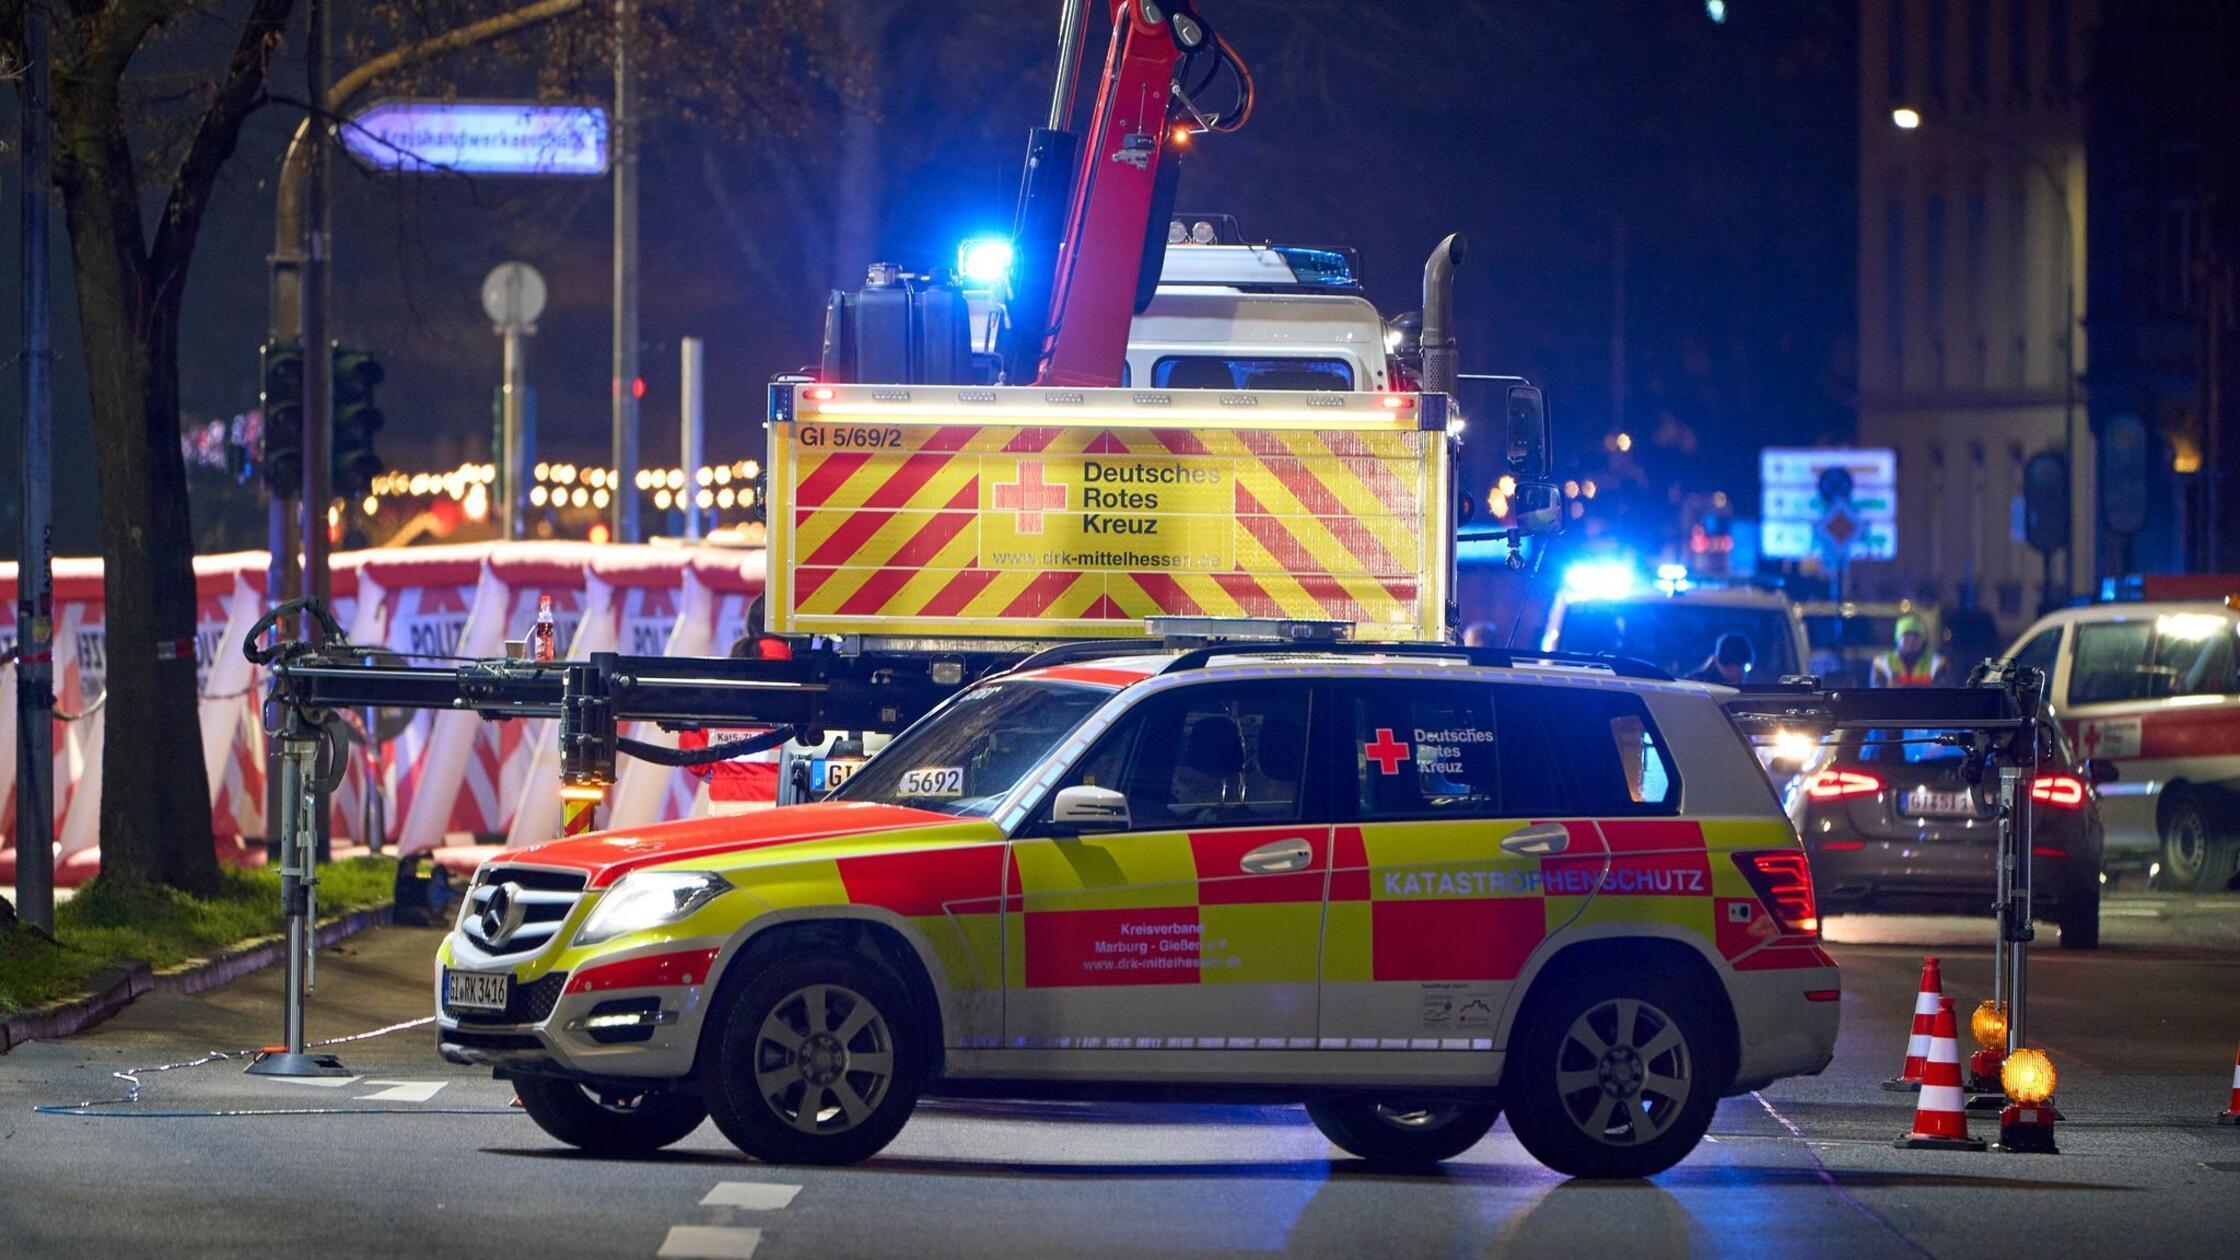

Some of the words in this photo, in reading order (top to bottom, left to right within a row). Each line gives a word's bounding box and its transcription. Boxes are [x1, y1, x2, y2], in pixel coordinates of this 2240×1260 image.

[801, 427, 825, 446] GI
[833, 428, 902, 447] 5/69/2
[1084, 462, 1221, 484] Deutsches
[1084, 487, 1158, 509] Rotes
[1083, 514, 1158, 534] Kreuz
[1414, 729, 1494, 743] Deutsches
[1417, 760, 1464, 773] Kreuz
[909, 770, 960, 792] 5692
[1384, 869, 1704, 895] KATASTROPHENSCHUTZ
[1120, 923, 1206, 935] Kreisverband
[1095, 941, 1148, 954] Marburg
[1159, 939, 1203, 952] Gießen
[451, 976, 459, 1001] GI
[465, 976, 477, 1003] RK
[479, 978, 505, 1004] 3416
